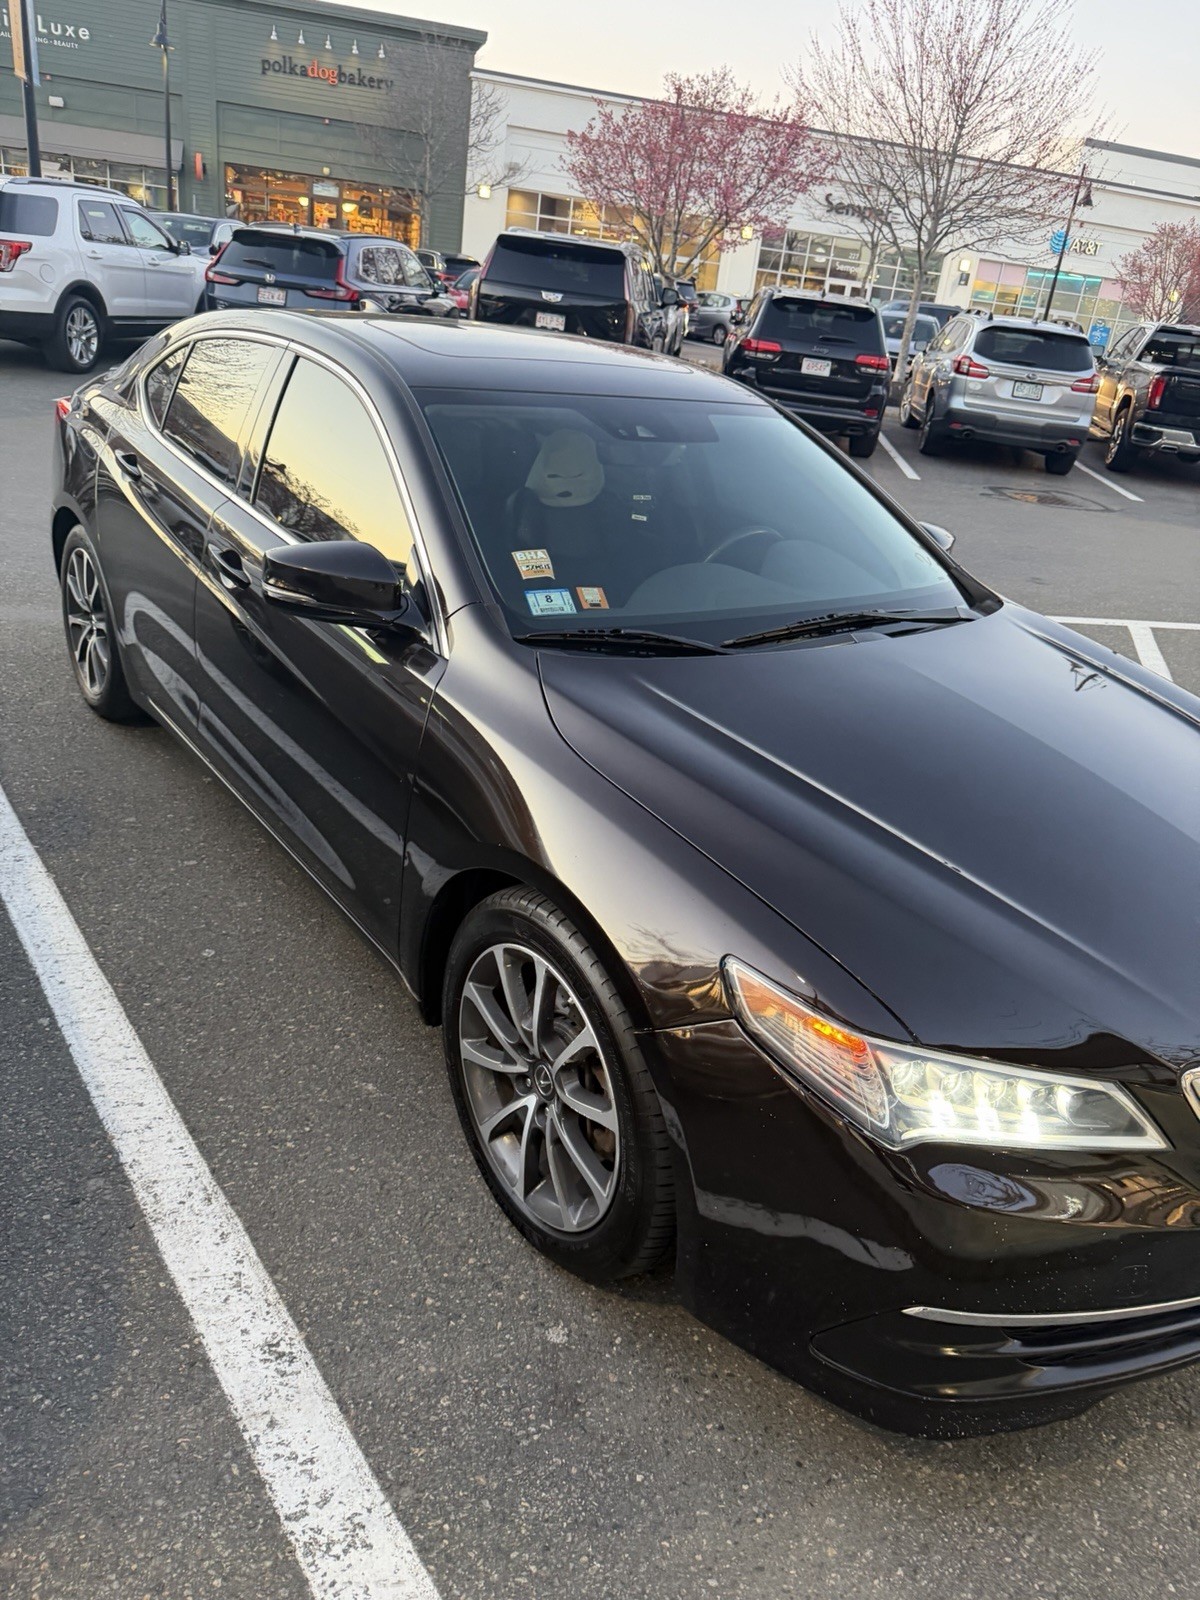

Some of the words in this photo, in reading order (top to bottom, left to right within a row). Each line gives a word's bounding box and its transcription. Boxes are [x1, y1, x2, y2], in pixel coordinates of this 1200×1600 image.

[53, 40, 79, 49] BEAUTY
[1070, 238, 1104, 256] AT&T
[516, 551, 547, 560] BHA
[545, 595, 553, 603] 8
